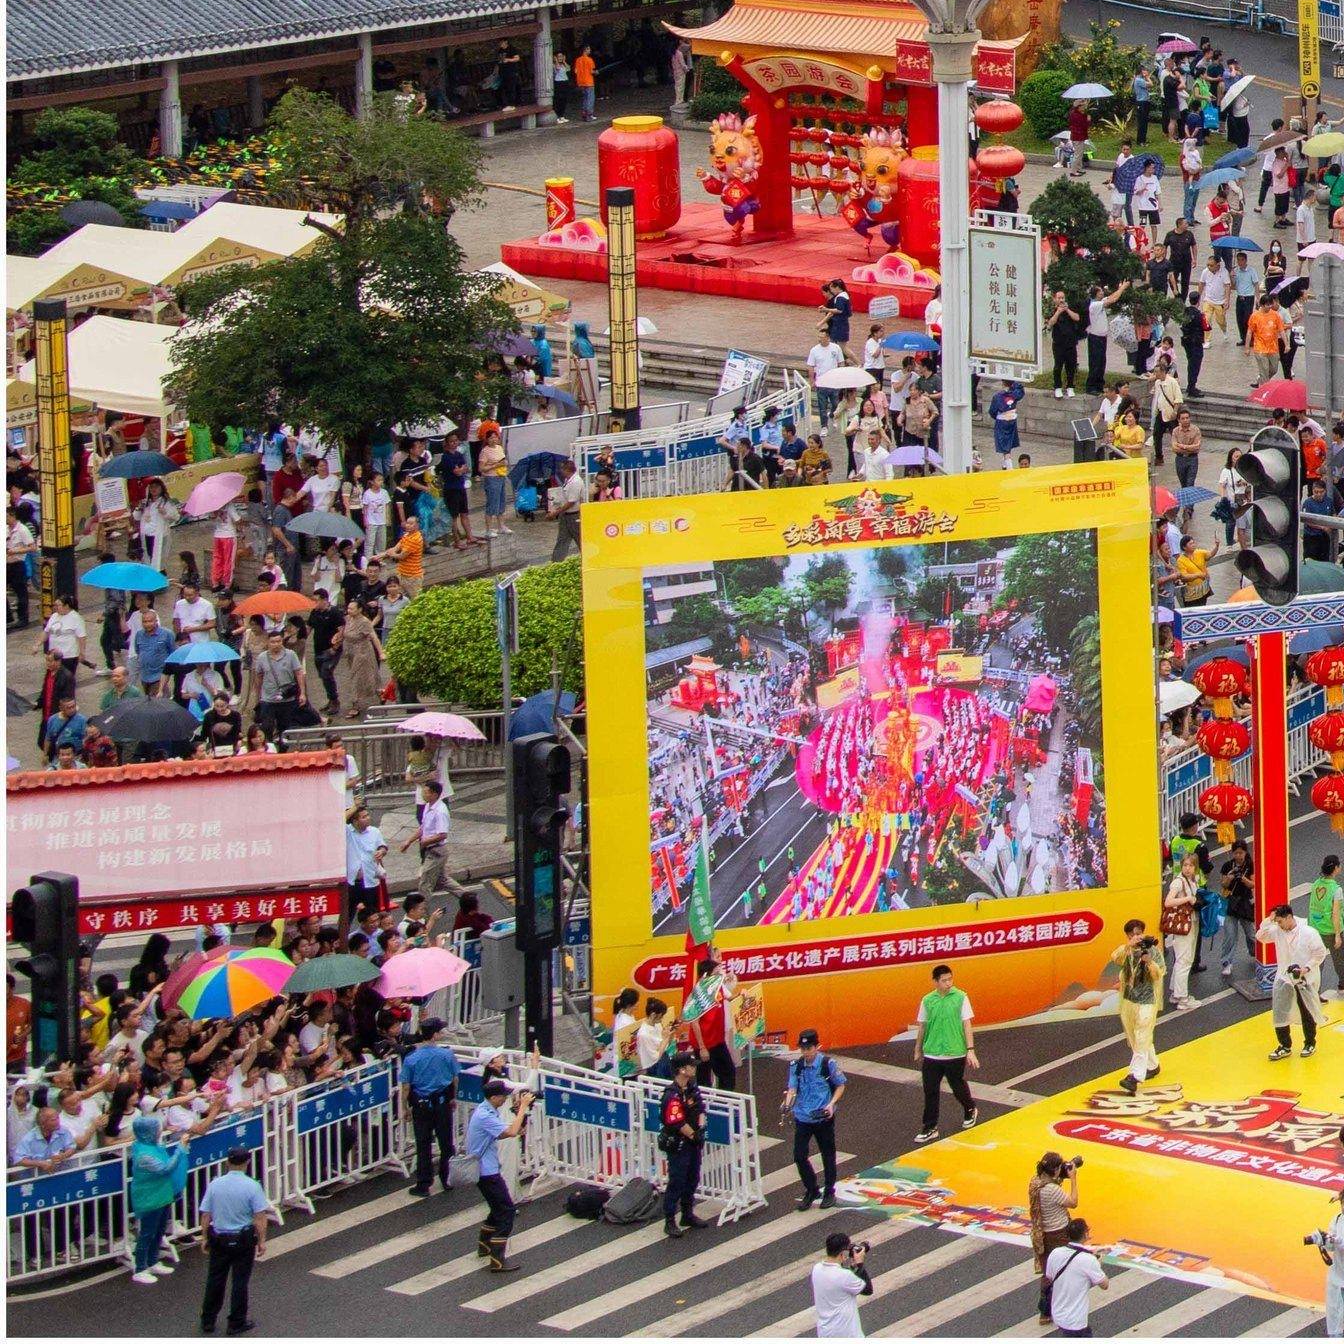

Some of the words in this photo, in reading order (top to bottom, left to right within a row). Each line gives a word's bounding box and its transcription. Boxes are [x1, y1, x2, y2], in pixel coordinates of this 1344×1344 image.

[759, 61, 854, 92] 茶园游会
[1217, 674, 1237, 693] 福
[1220, 737, 1240, 755] 福
[1204, 795, 1222, 814] 福
[1234, 795, 1250, 814] 福
[1324, 791, 1343, 809] 福
[46, 820, 223, 851] 推进高质量发展
[97, 839, 274, 870] 构建新发展格局
[85, 908, 160, 931] 守秩序
[179, 895, 329, 924] 共享美好生活
[649, 918, 1090, 983] 广东物质文化遗产展示系列活动暨2024茶园游会
[313, 1095, 376, 1124] POLICE
[561, 1109, 617, 1127] POLICE
[22, 1185, 100, 1210] POLICE
